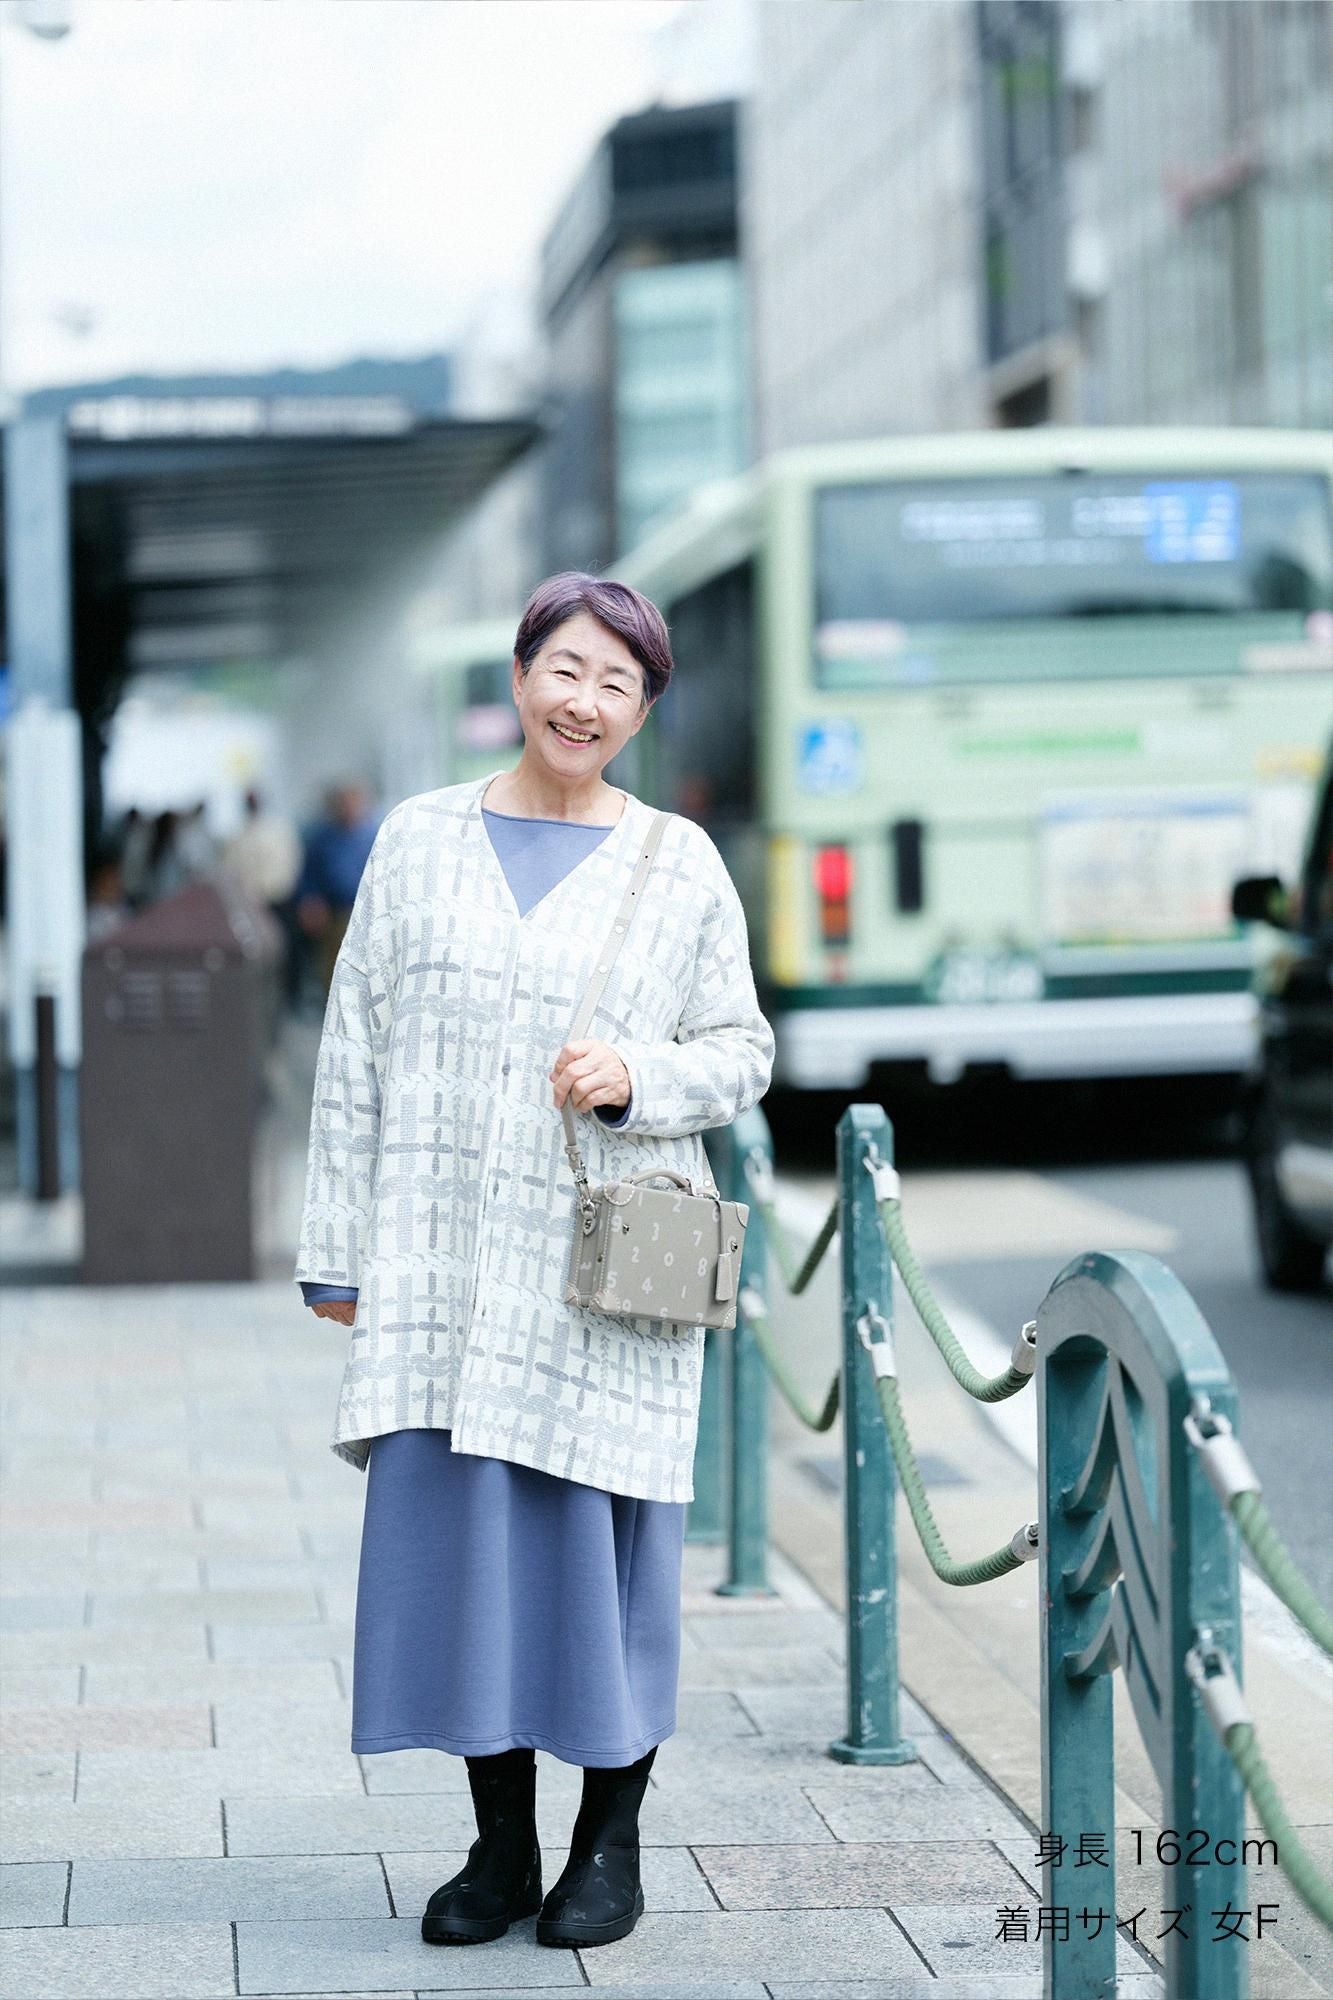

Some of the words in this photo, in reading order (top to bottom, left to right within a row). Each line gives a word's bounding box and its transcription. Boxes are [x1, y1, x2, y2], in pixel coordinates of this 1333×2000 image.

[672, 1196, 683, 1213] 2
[610, 1214, 623, 1233] 9
[651, 1222, 660, 1241] 3
[692, 1230, 703, 1247] 7
[631, 1246, 640, 1263] 2
[663, 1251, 674, 1267] 0
[697, 1257, 708, 1277] 8
[606, 1271, 618, 1289] 5
[641, 1277, 653, 1295] 4
[681, 1285, 687, 1299] 1
